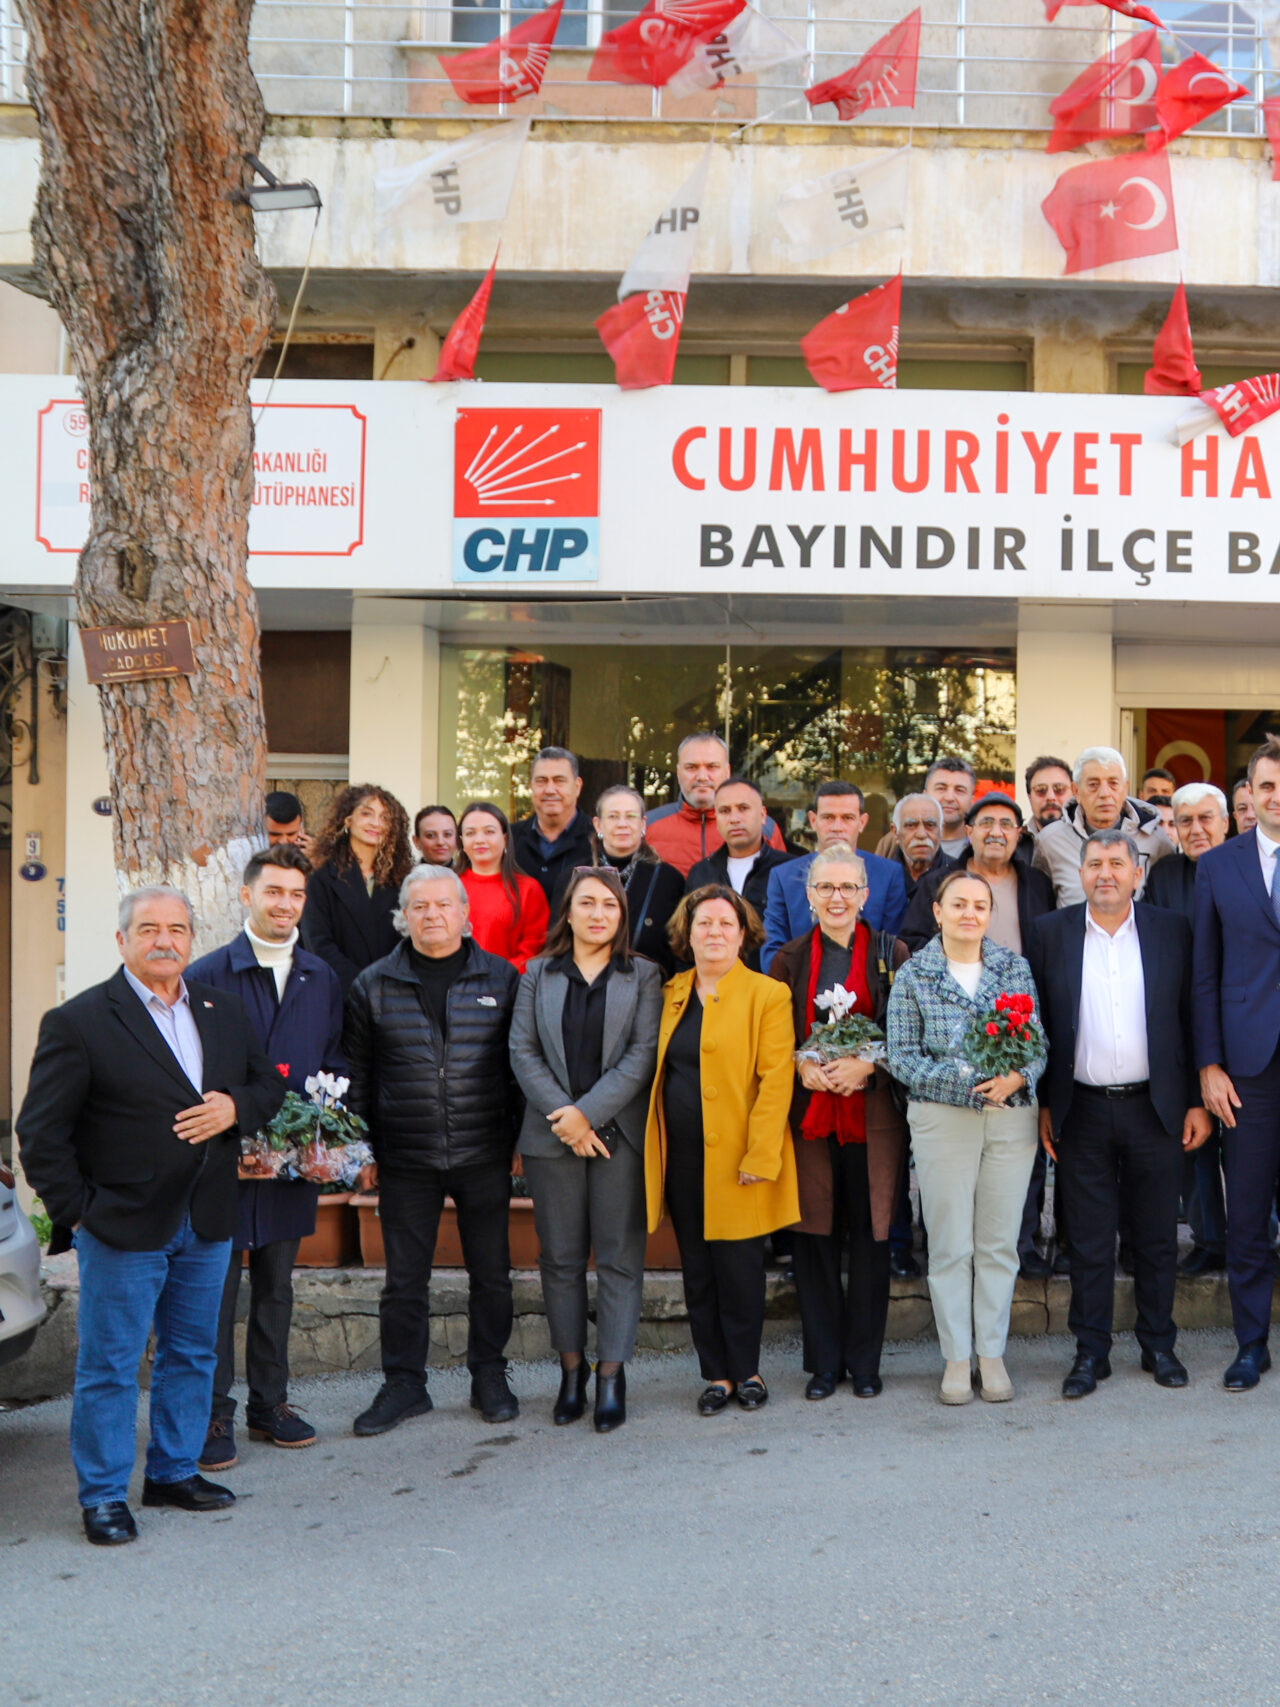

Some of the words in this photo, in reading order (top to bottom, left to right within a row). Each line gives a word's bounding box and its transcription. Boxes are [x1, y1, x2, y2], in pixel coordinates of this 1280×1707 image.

[431, 162, 462, 215] HP
[653, 206, 700, 235] HP
[252, 448, 328, 473] AKANLIĞI
[671, 413, 1143, 497] CUMHURİYET
[252, 481, 355, 507] ÜTÜPHANESİ
[463, 527, 589, 573] CHP
[699, 524, 1028, 571] BAYINDIR
[1060, 514, 1194, 587] İLÇE
